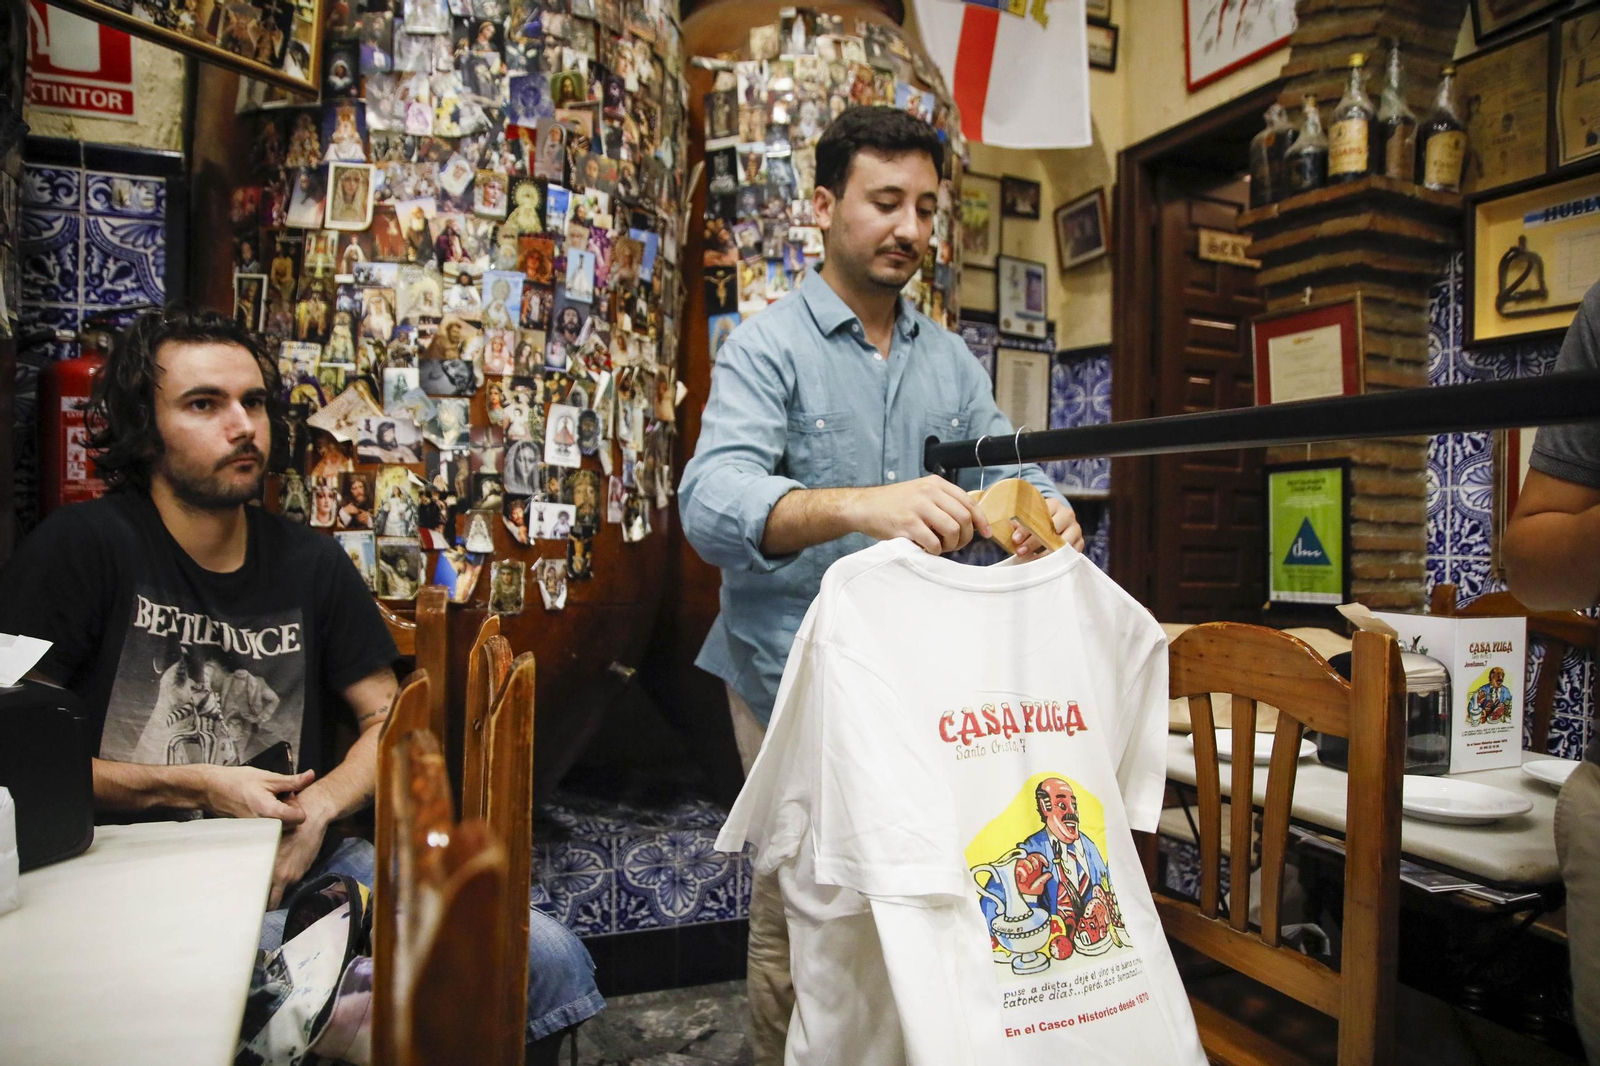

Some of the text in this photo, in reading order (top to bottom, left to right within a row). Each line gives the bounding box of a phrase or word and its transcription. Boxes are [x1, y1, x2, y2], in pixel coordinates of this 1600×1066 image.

[1469, 641, 1491, 655] CASA
[938, 700, 1088, 746] CASA PUGA
[955, 743, 986, 760] Santo
[1003, 987, 1026, 1001] puse
[1030, 986, 1038, 994] a
[1041, 980, 1072, 992] dieta,
[1090, 970, 1097, 980] el
[1003, 993, 1045, 1009] catorce
[1005, 992, 1149, 1038] En el Casco Historico desde 1870
